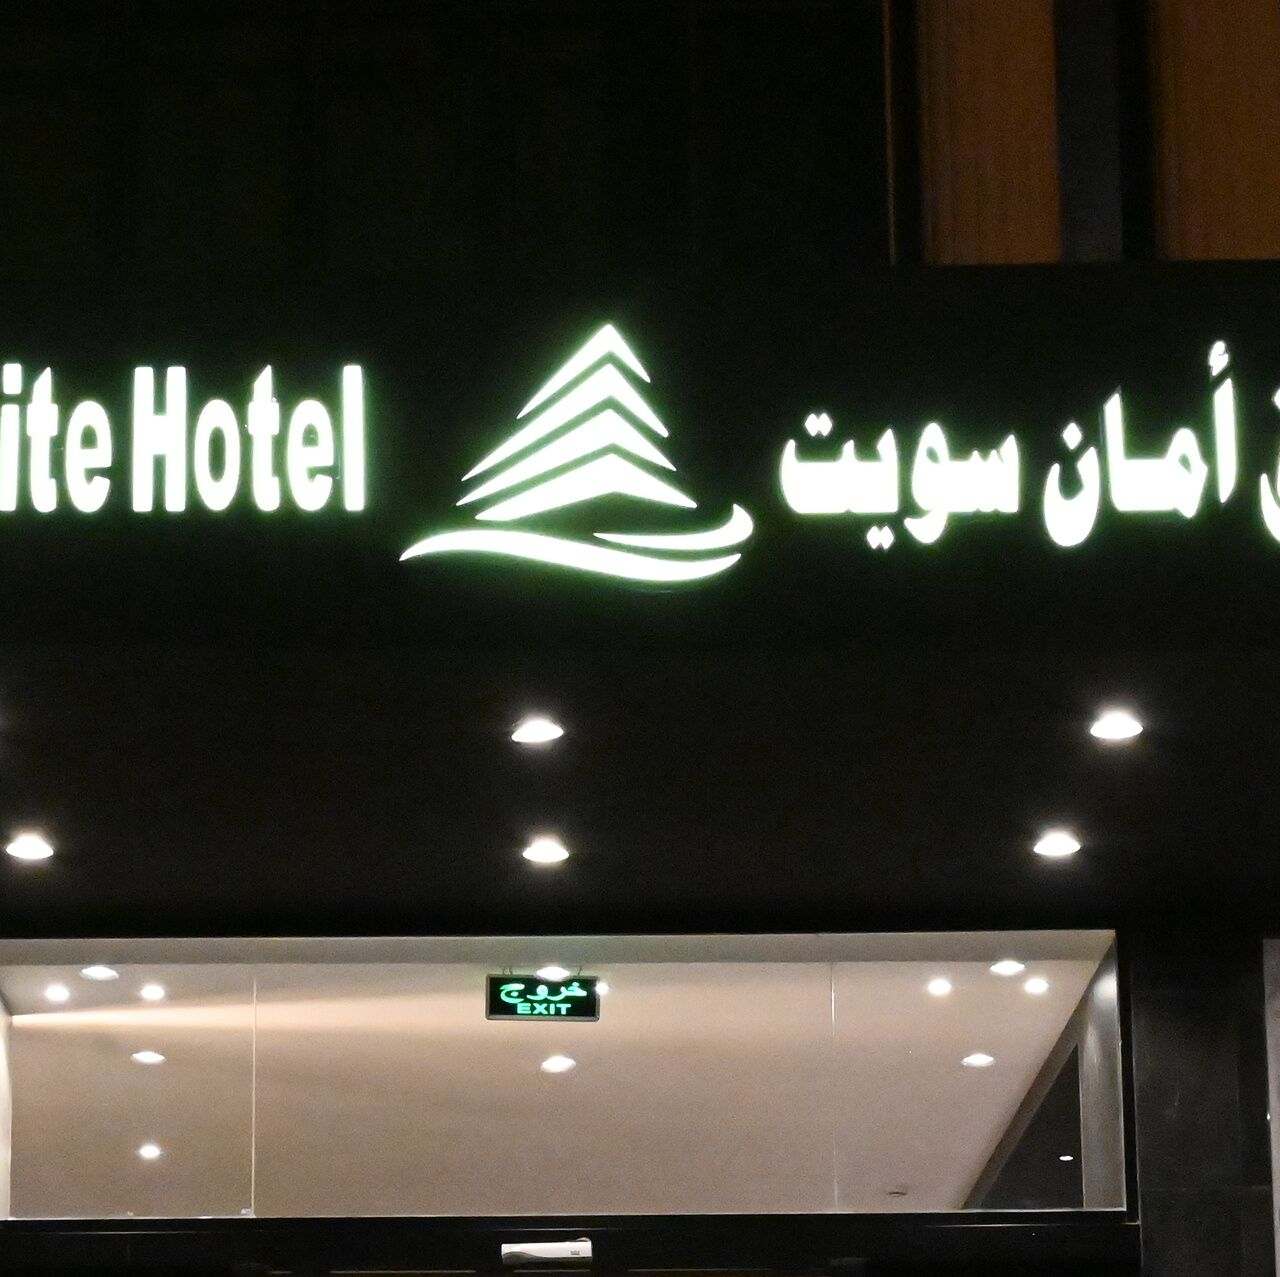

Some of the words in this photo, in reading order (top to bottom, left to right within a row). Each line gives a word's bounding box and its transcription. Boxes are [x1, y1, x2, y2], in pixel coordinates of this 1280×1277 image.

[131, 364, 367, 513] Hotel
[779, 412, 1021, 550] سويت
[1042, 340, 1238, 548] أمان
[499, 981, 588, 1004] خروج
[516, 1003, 571, 1015] EXIT
